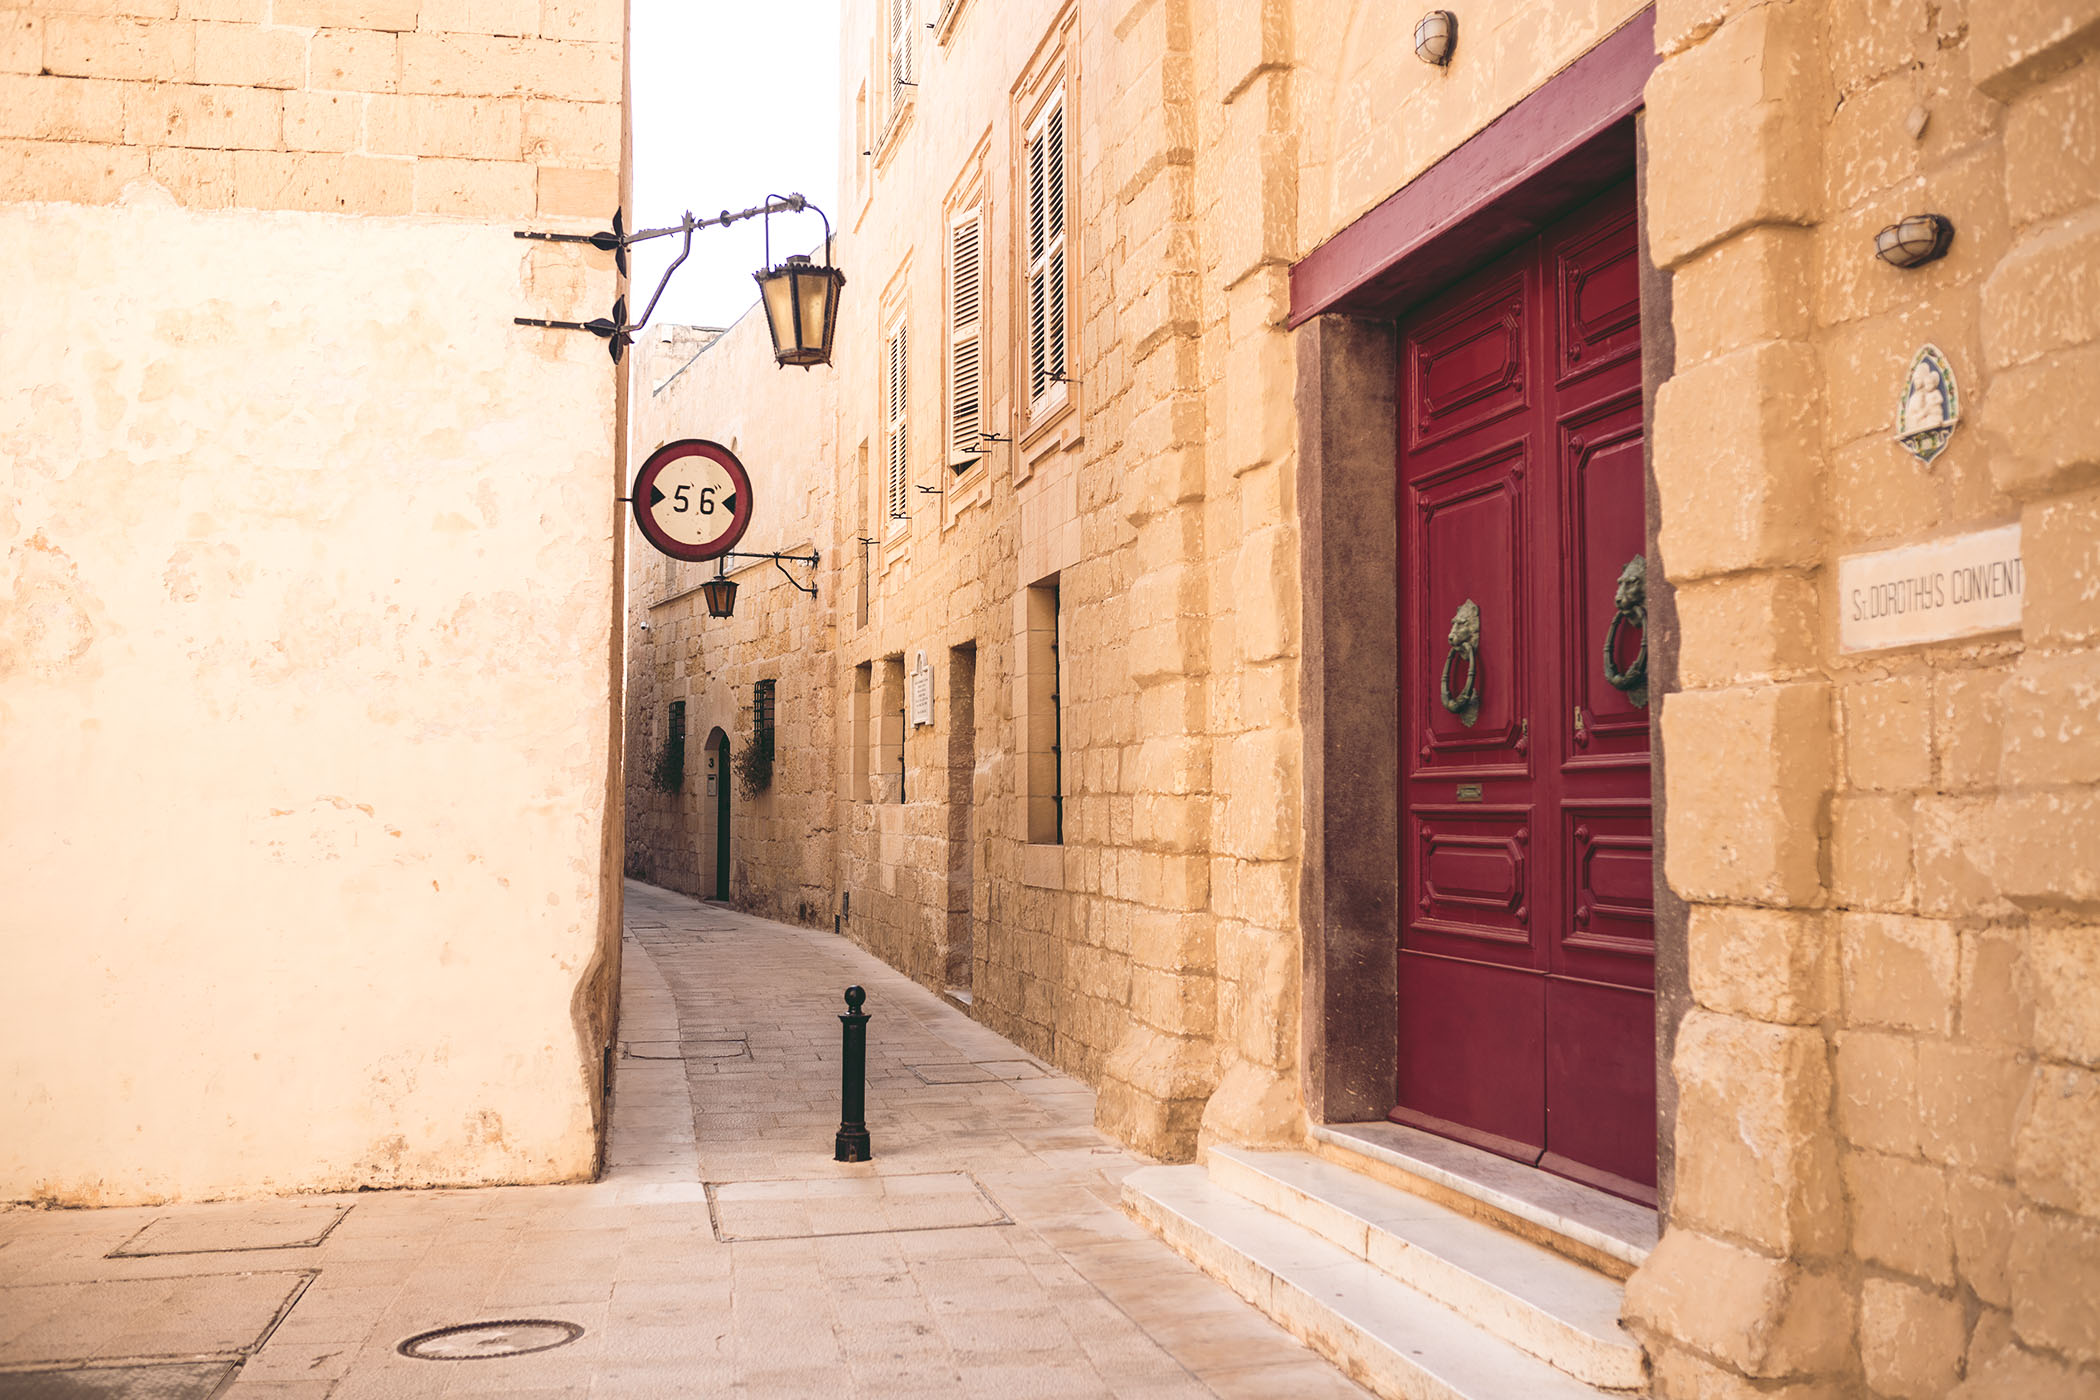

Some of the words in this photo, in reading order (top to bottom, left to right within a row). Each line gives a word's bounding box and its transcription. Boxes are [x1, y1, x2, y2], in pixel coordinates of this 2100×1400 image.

[1871, 573, 1944, 618] DOROTHY'S
[1953, 557, 2021, 605] CONVENT
[708, 757, 714, 768] 3
